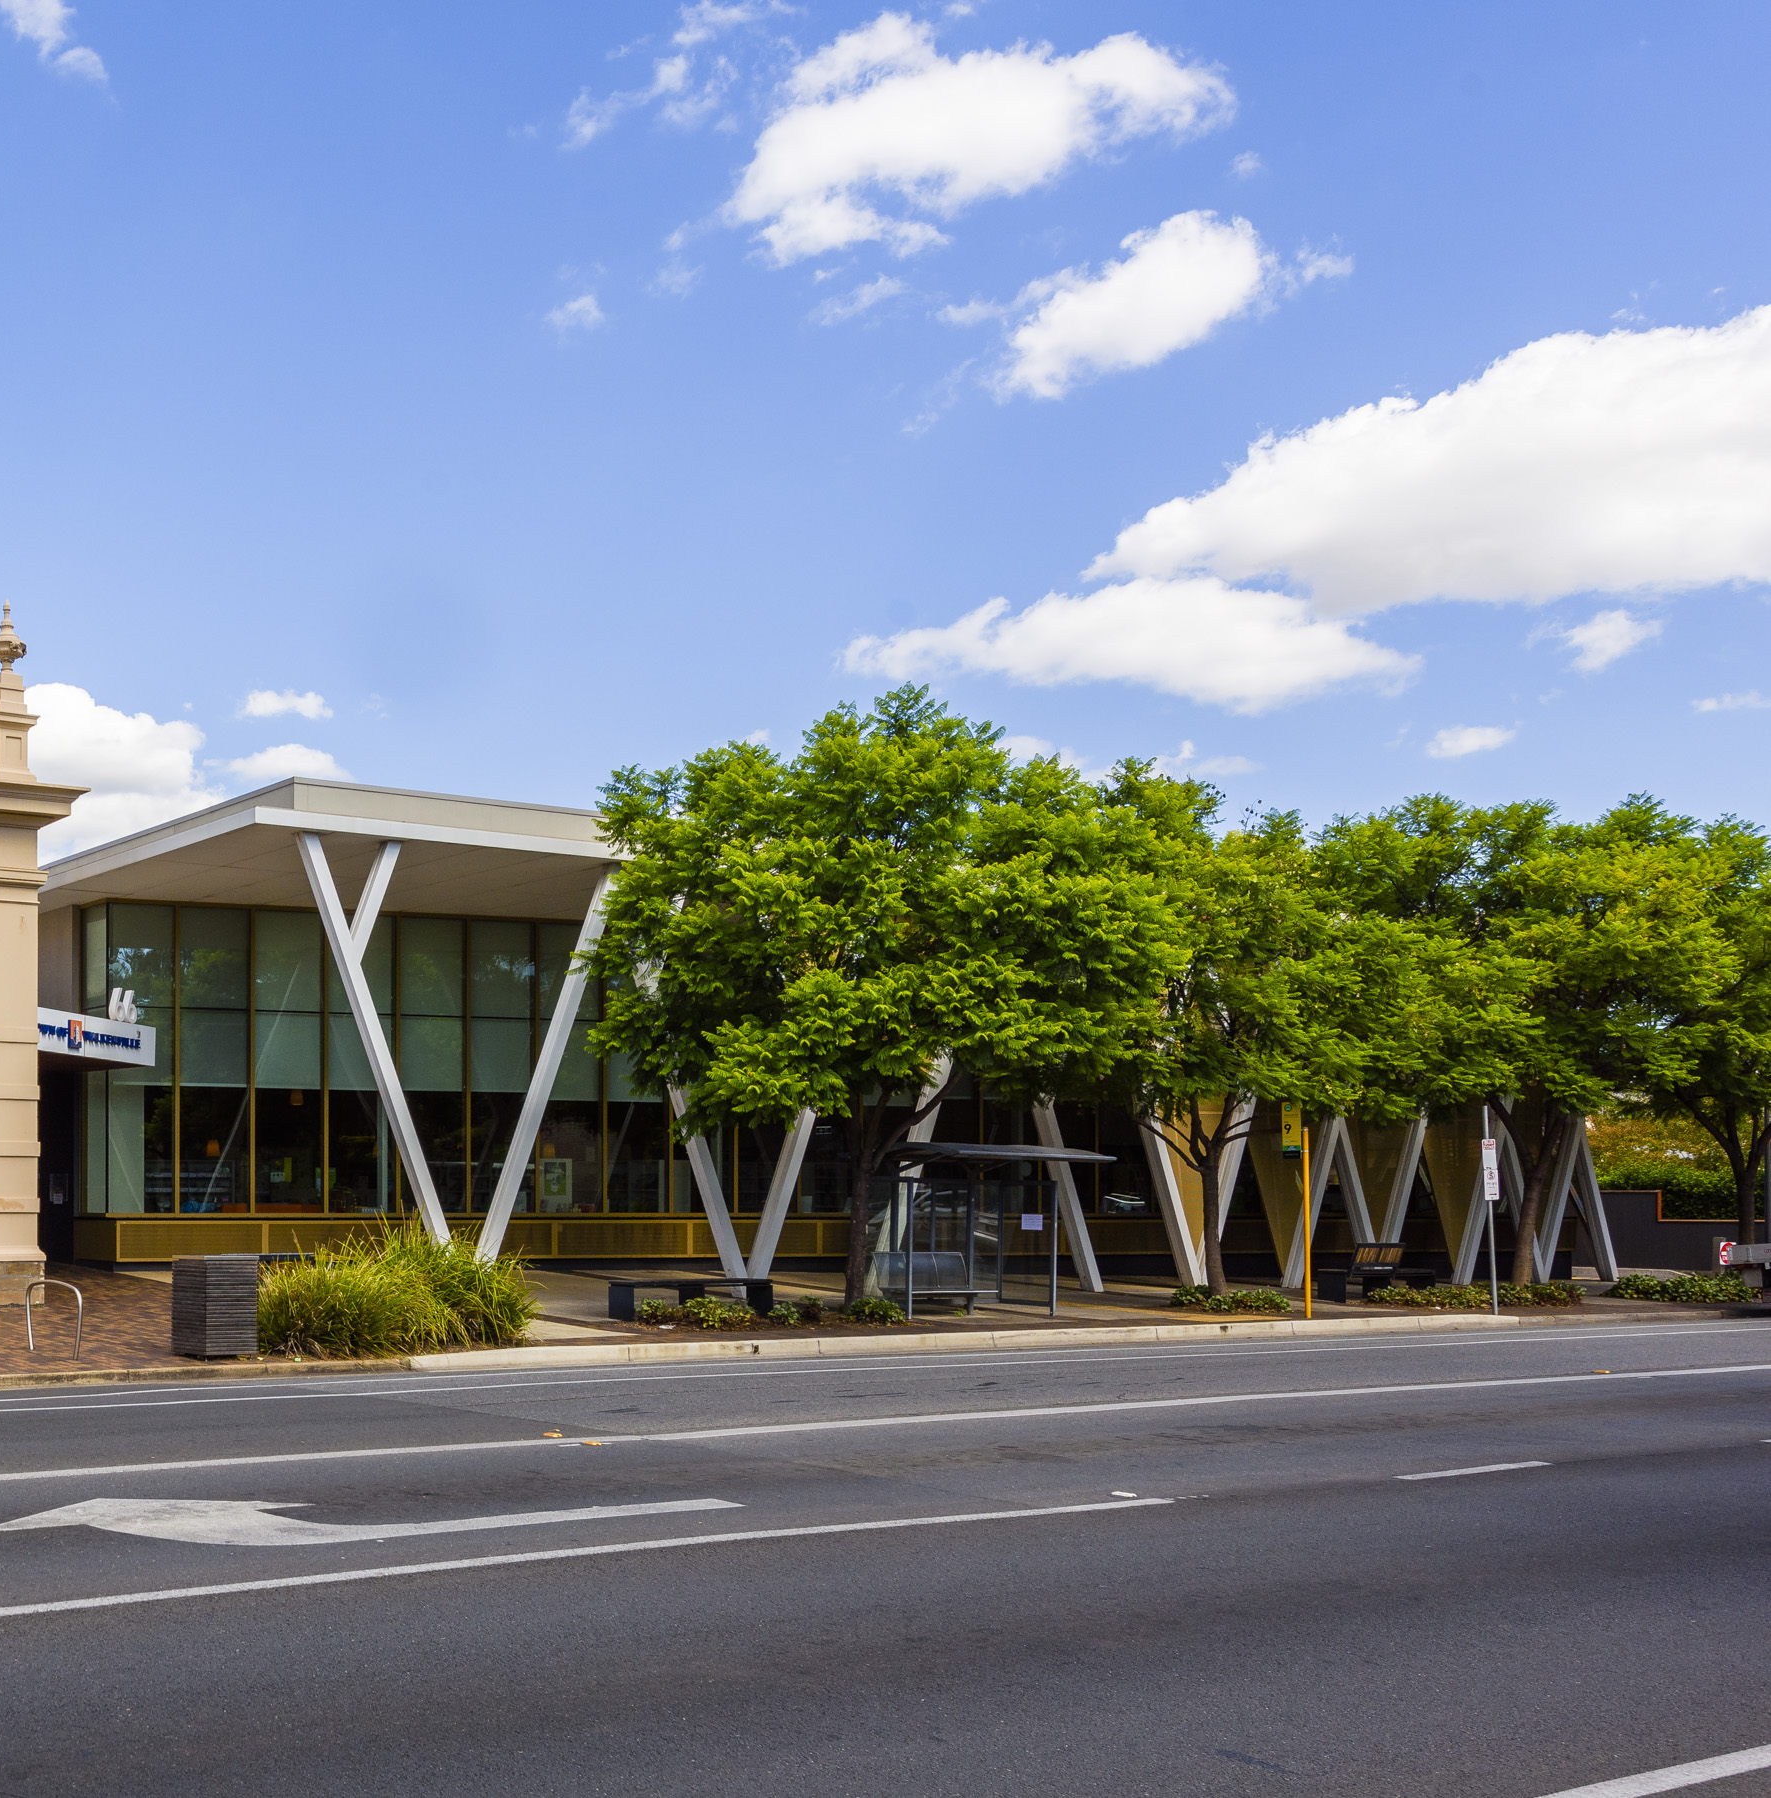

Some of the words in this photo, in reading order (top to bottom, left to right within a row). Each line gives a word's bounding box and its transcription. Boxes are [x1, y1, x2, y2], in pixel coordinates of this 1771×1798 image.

[108, 987, 137, 1024] 66
[82, 1030, 141, 1049] WALKERVILLE
[1284, 1123, 1292, 1135] 9
